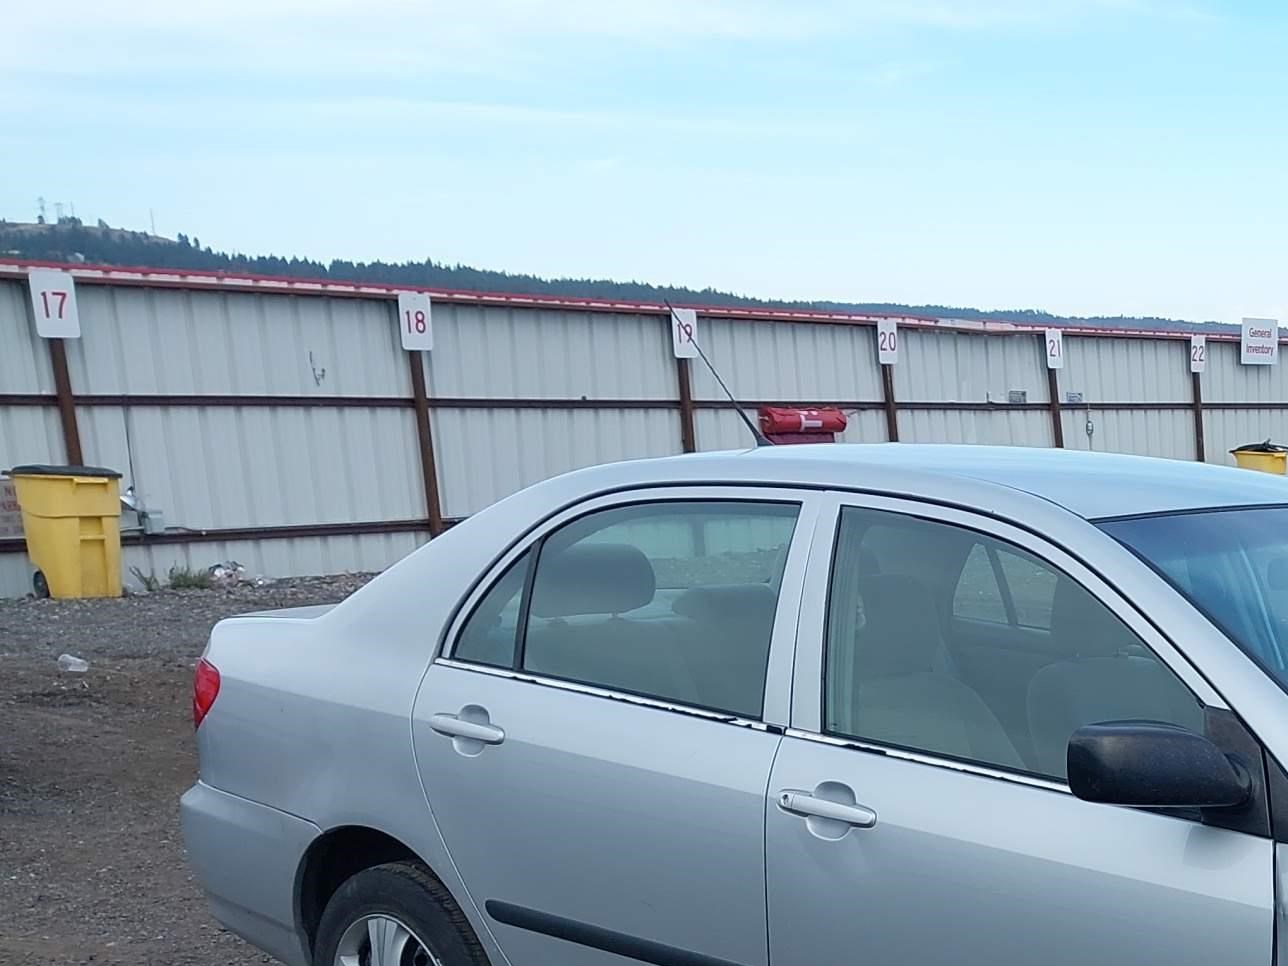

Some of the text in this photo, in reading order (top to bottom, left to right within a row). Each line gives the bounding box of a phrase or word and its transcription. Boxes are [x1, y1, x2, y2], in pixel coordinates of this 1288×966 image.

[40, 291, 68, 319] 17
[405, 309, 428, 335] 18
[677, 322, 693, 343] 19
[879, 332, 896, 351] 20
[1248, 327, 1272, 338] General
[1049, 339, 1061, 357] 21
[1191, 345, 1205, 362] 22
[1246, 343, 1274, 357] Inventory
